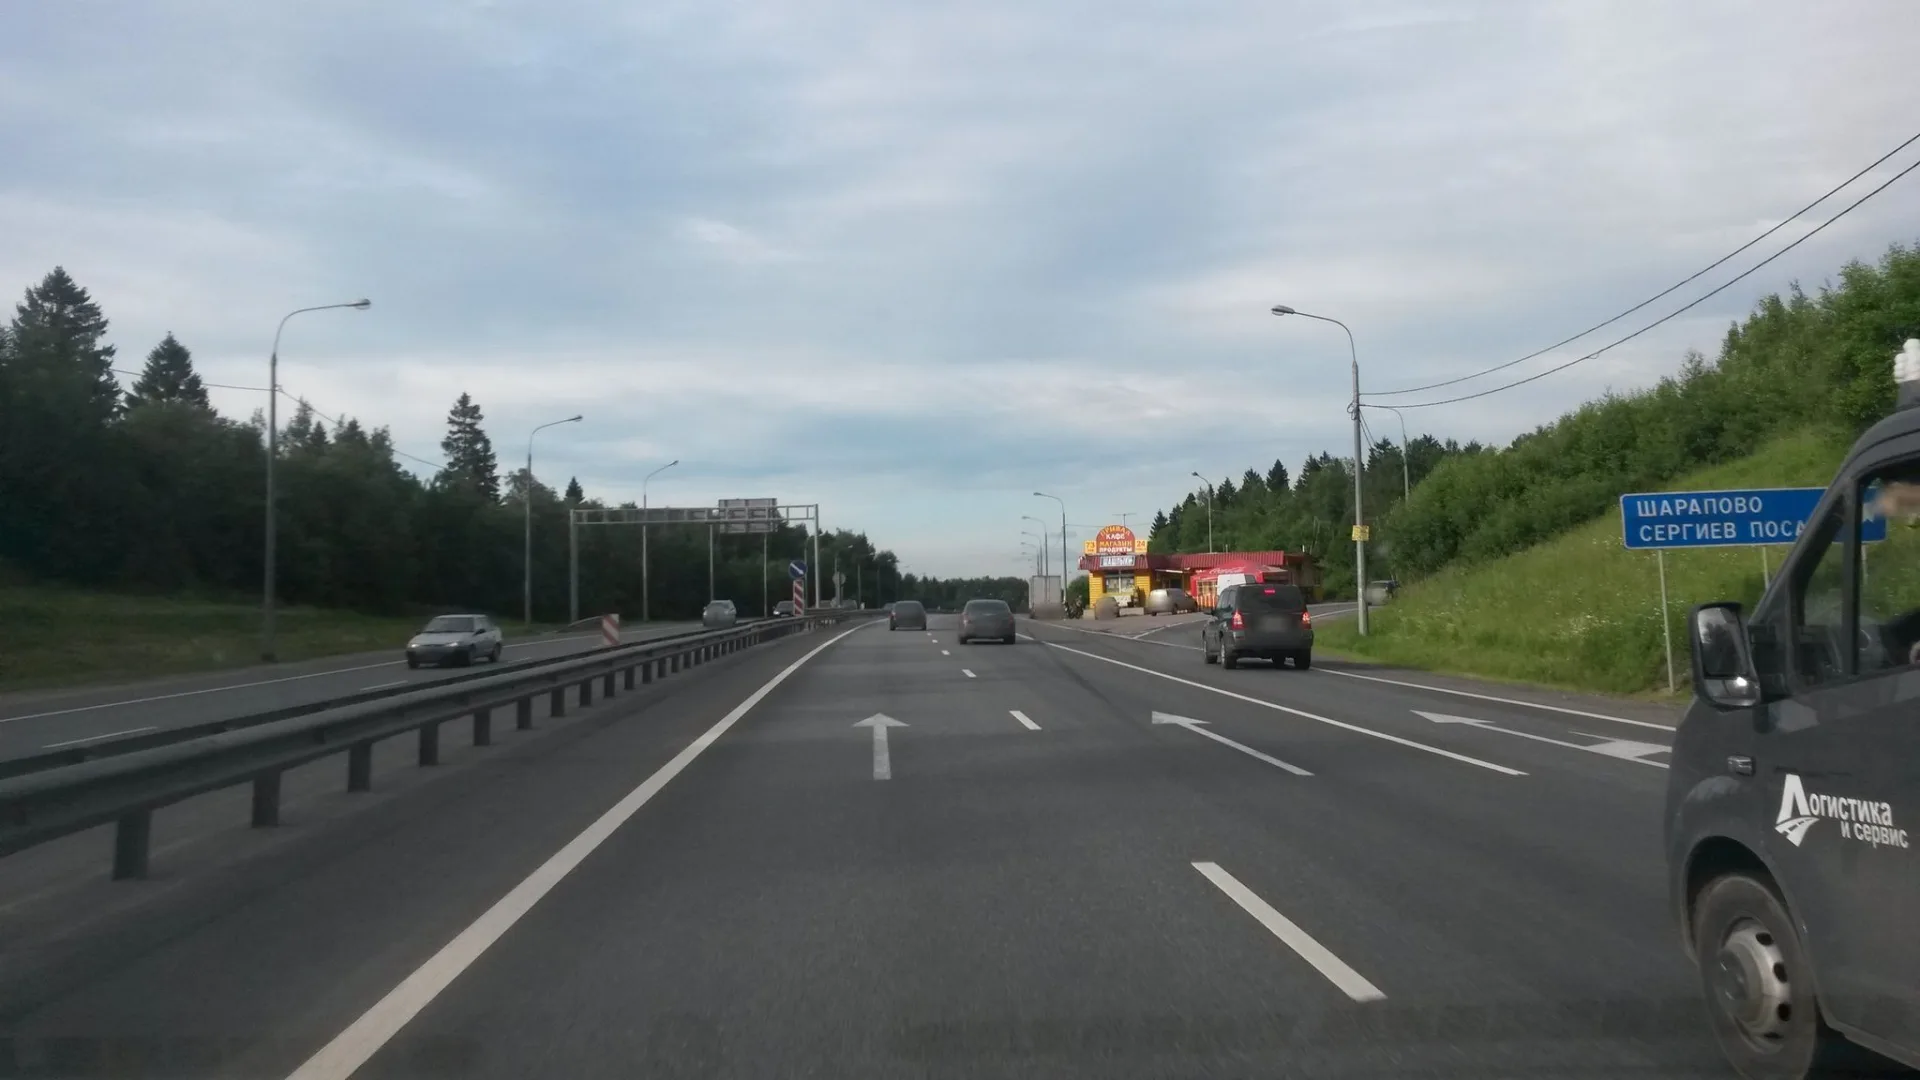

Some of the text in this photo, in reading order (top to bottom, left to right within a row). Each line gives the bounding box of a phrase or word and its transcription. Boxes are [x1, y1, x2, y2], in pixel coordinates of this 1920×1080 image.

[1636, 496, 1763, 517] ШАРАПОВО
[1639, 520, 1808, 542] СЕРГИЕВ ПОСА
[1776, 773, 1893, 827] Логистика
[1840, 820, 1909, 849] и сервис
